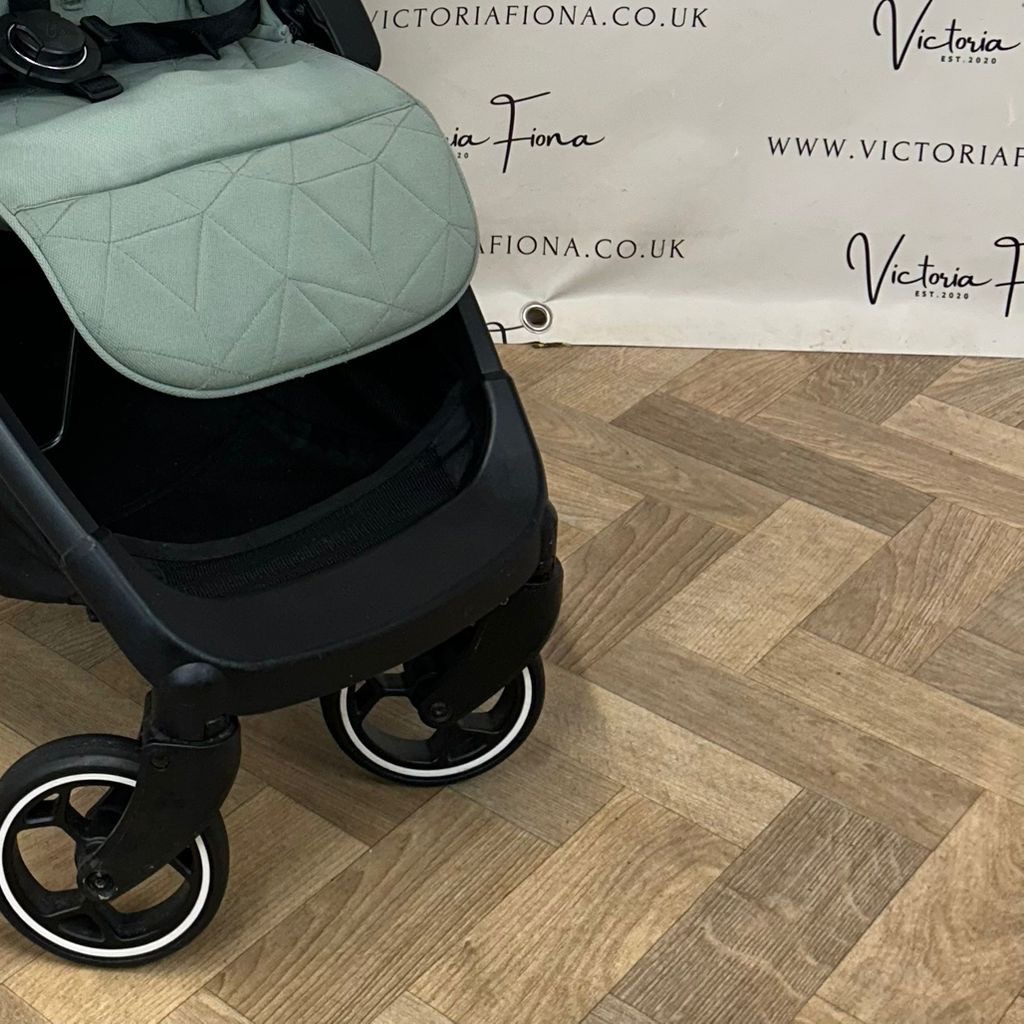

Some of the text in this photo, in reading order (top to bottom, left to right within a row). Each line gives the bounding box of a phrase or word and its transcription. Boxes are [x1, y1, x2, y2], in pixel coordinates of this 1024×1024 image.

[941, 56, 996, 64] EST.2020
[490, 92, 605, 174] Fiona
[846, 232, 993, 305] Victoria
[915, 291, 969, 299] EST.2020
